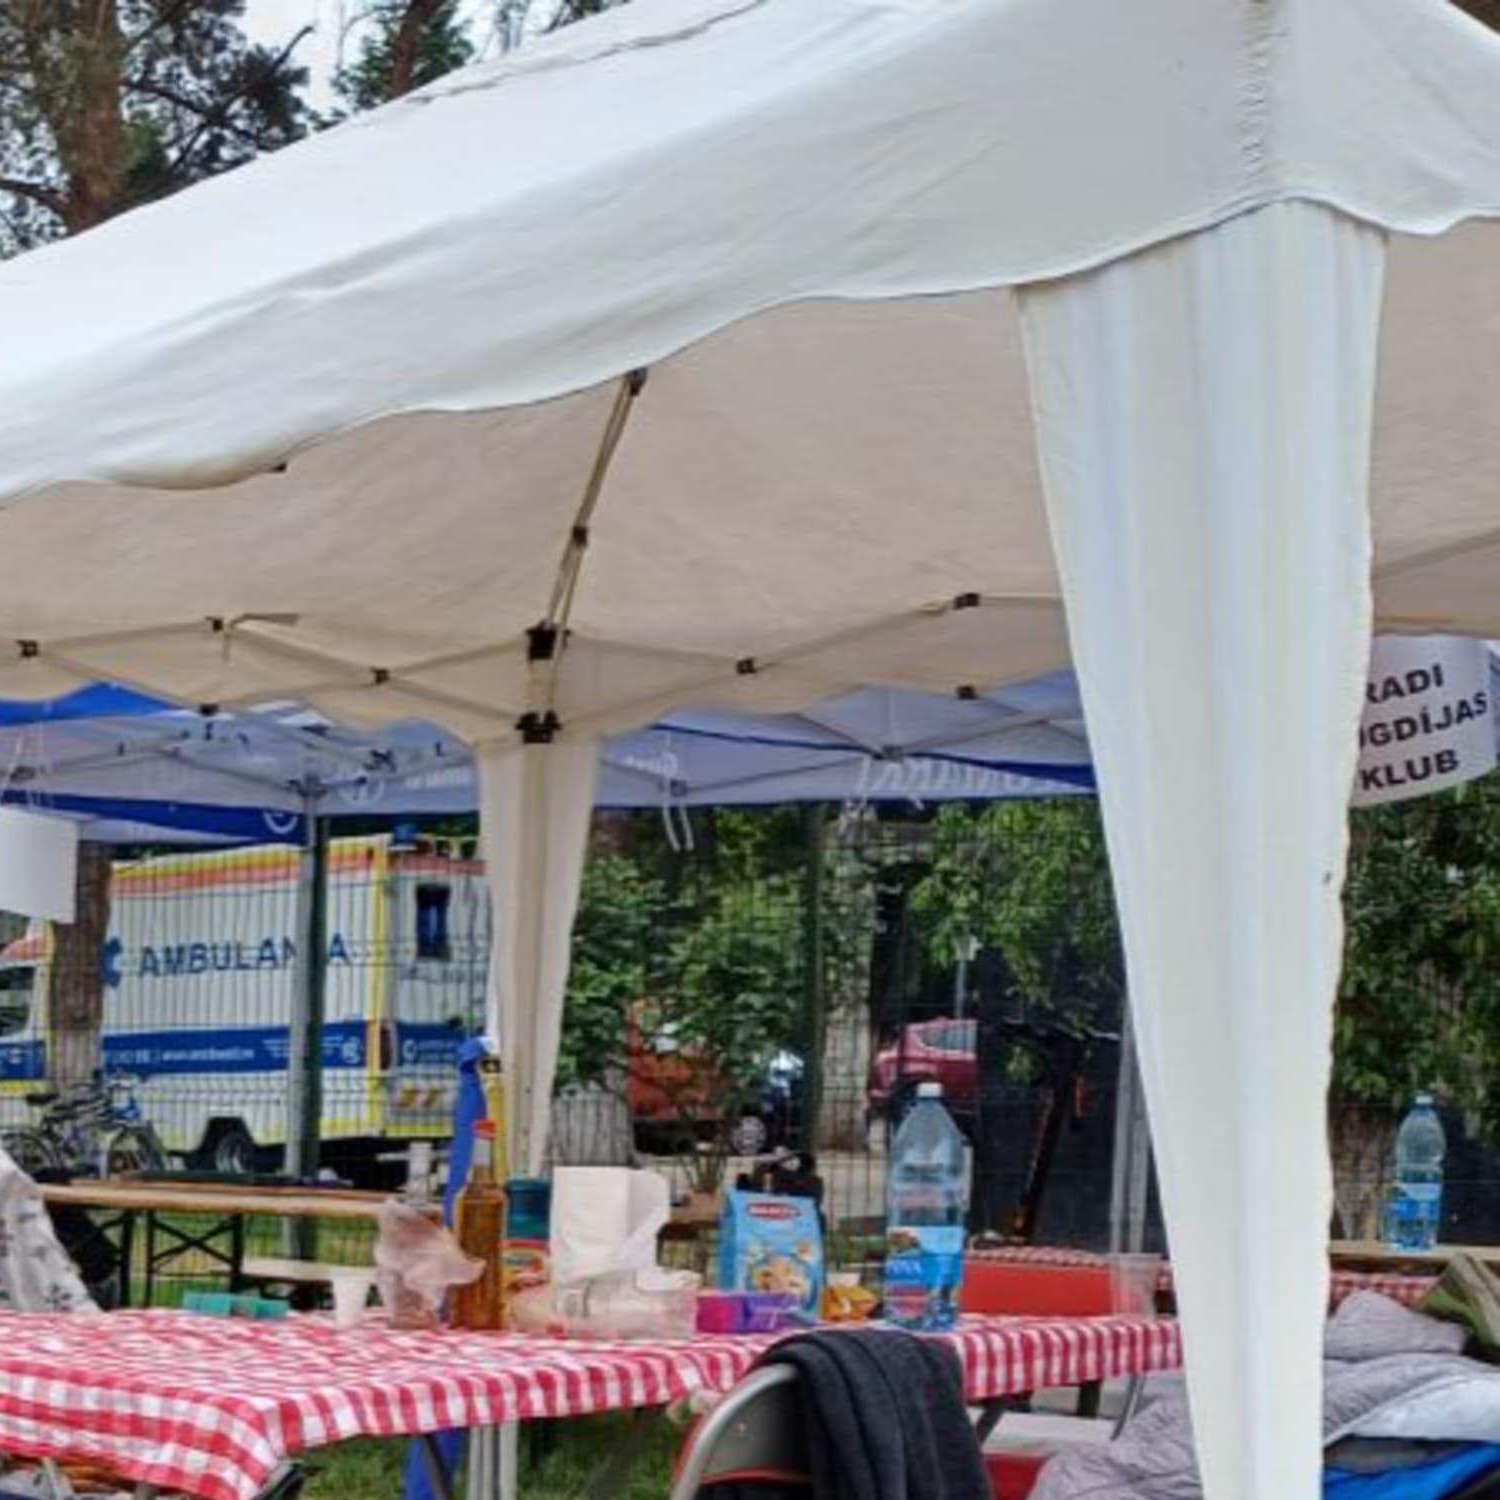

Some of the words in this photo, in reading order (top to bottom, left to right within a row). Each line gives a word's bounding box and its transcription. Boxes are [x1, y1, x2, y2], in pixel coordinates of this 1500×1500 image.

[1359, 691, 1487, 750] GDÍJAS
[1360, 749, 1459, 790] KLUB
[138, 932, 350, 978] AMBULANA
